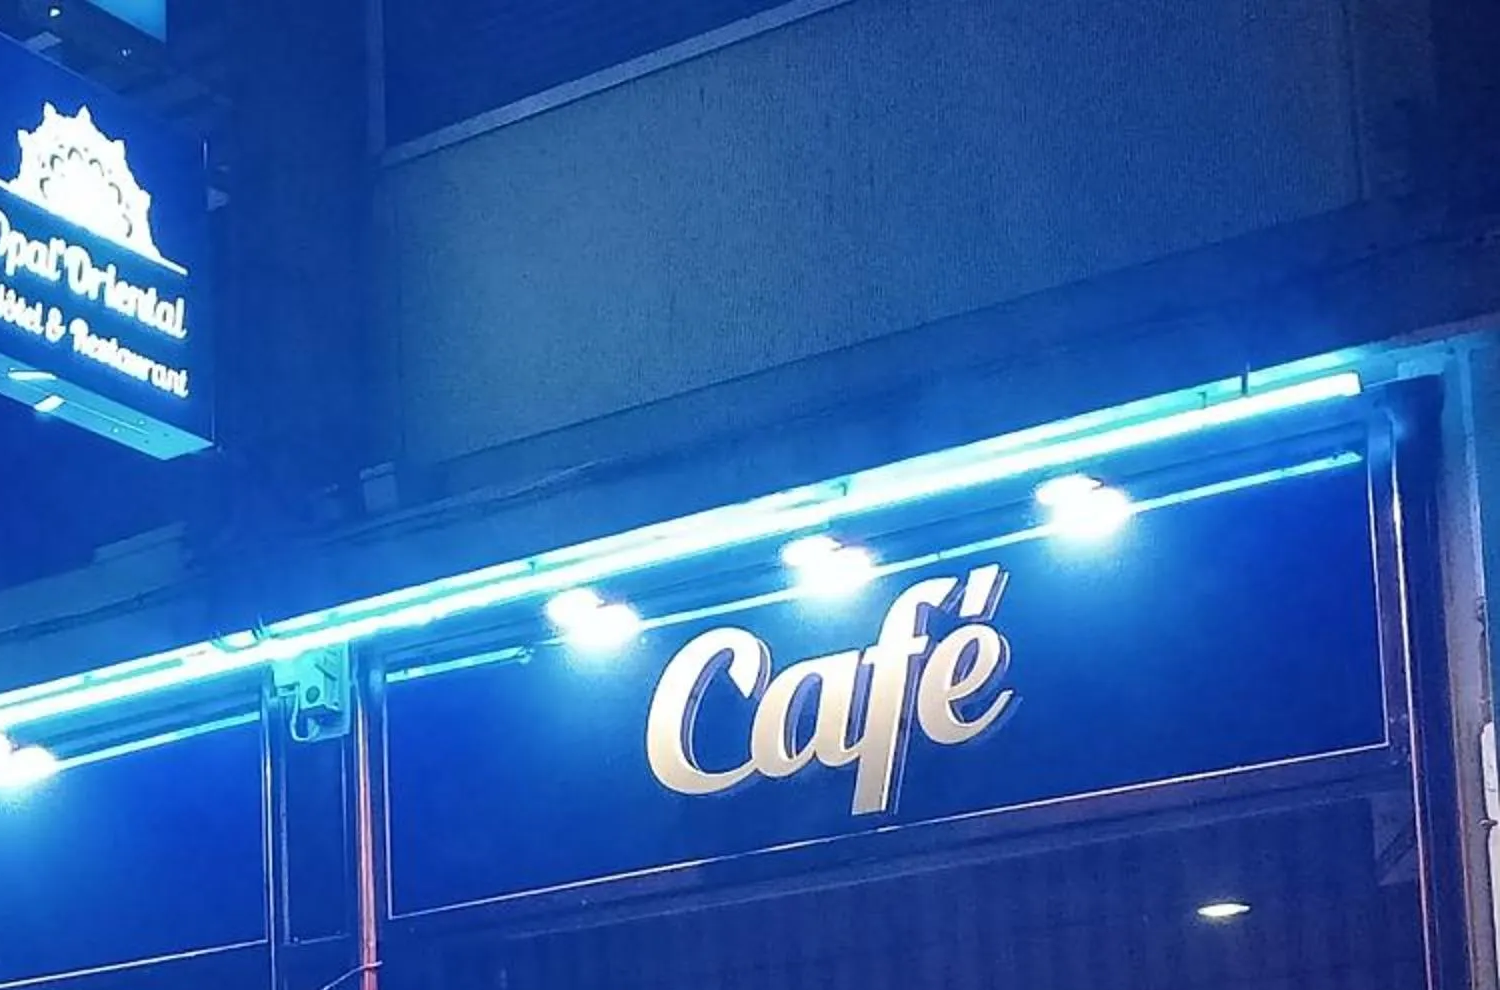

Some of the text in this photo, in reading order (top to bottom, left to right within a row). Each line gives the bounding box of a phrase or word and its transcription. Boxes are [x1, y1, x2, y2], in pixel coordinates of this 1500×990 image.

[45, 307, 66, 342] &
[69, 318, 189, 398] Restaurant
[645, 563, 1015, 817] Café
